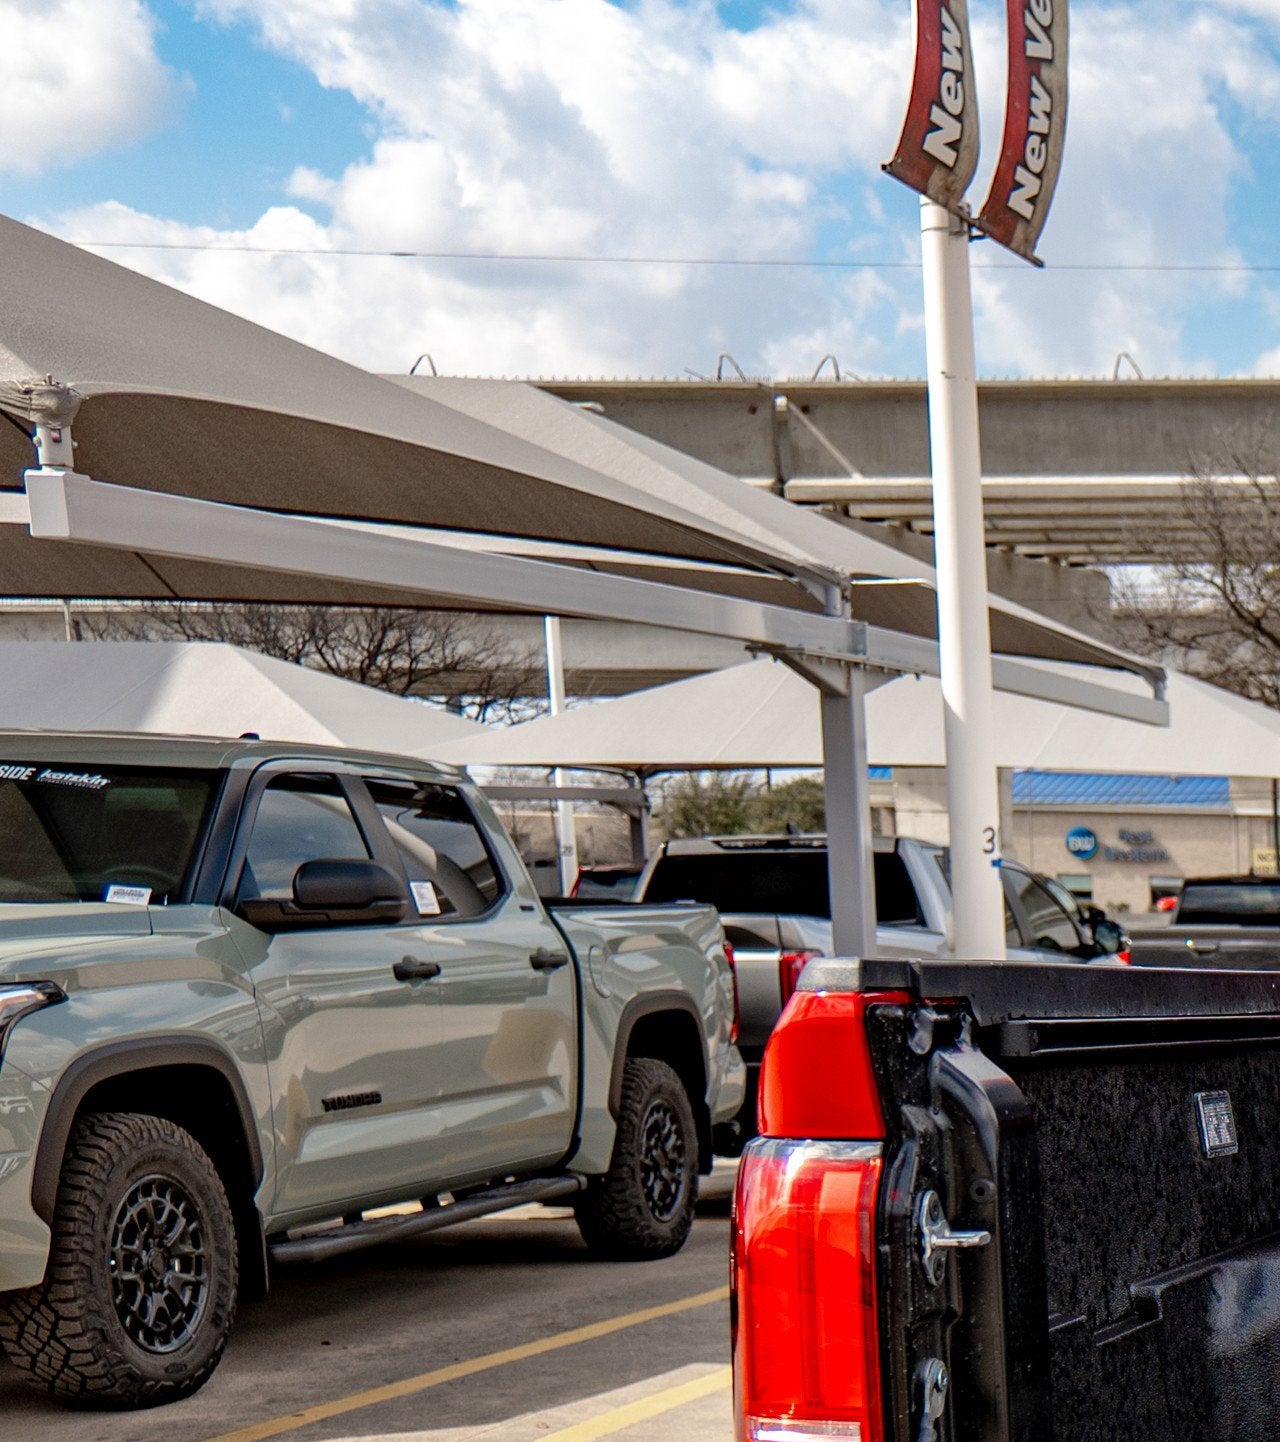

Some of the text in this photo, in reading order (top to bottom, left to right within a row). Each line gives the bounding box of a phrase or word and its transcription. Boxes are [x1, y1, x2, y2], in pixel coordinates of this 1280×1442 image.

[922, 6, 965, 168] New
[1006, 74, 1051, 221] New
[982, 826, 996, 854] 3
